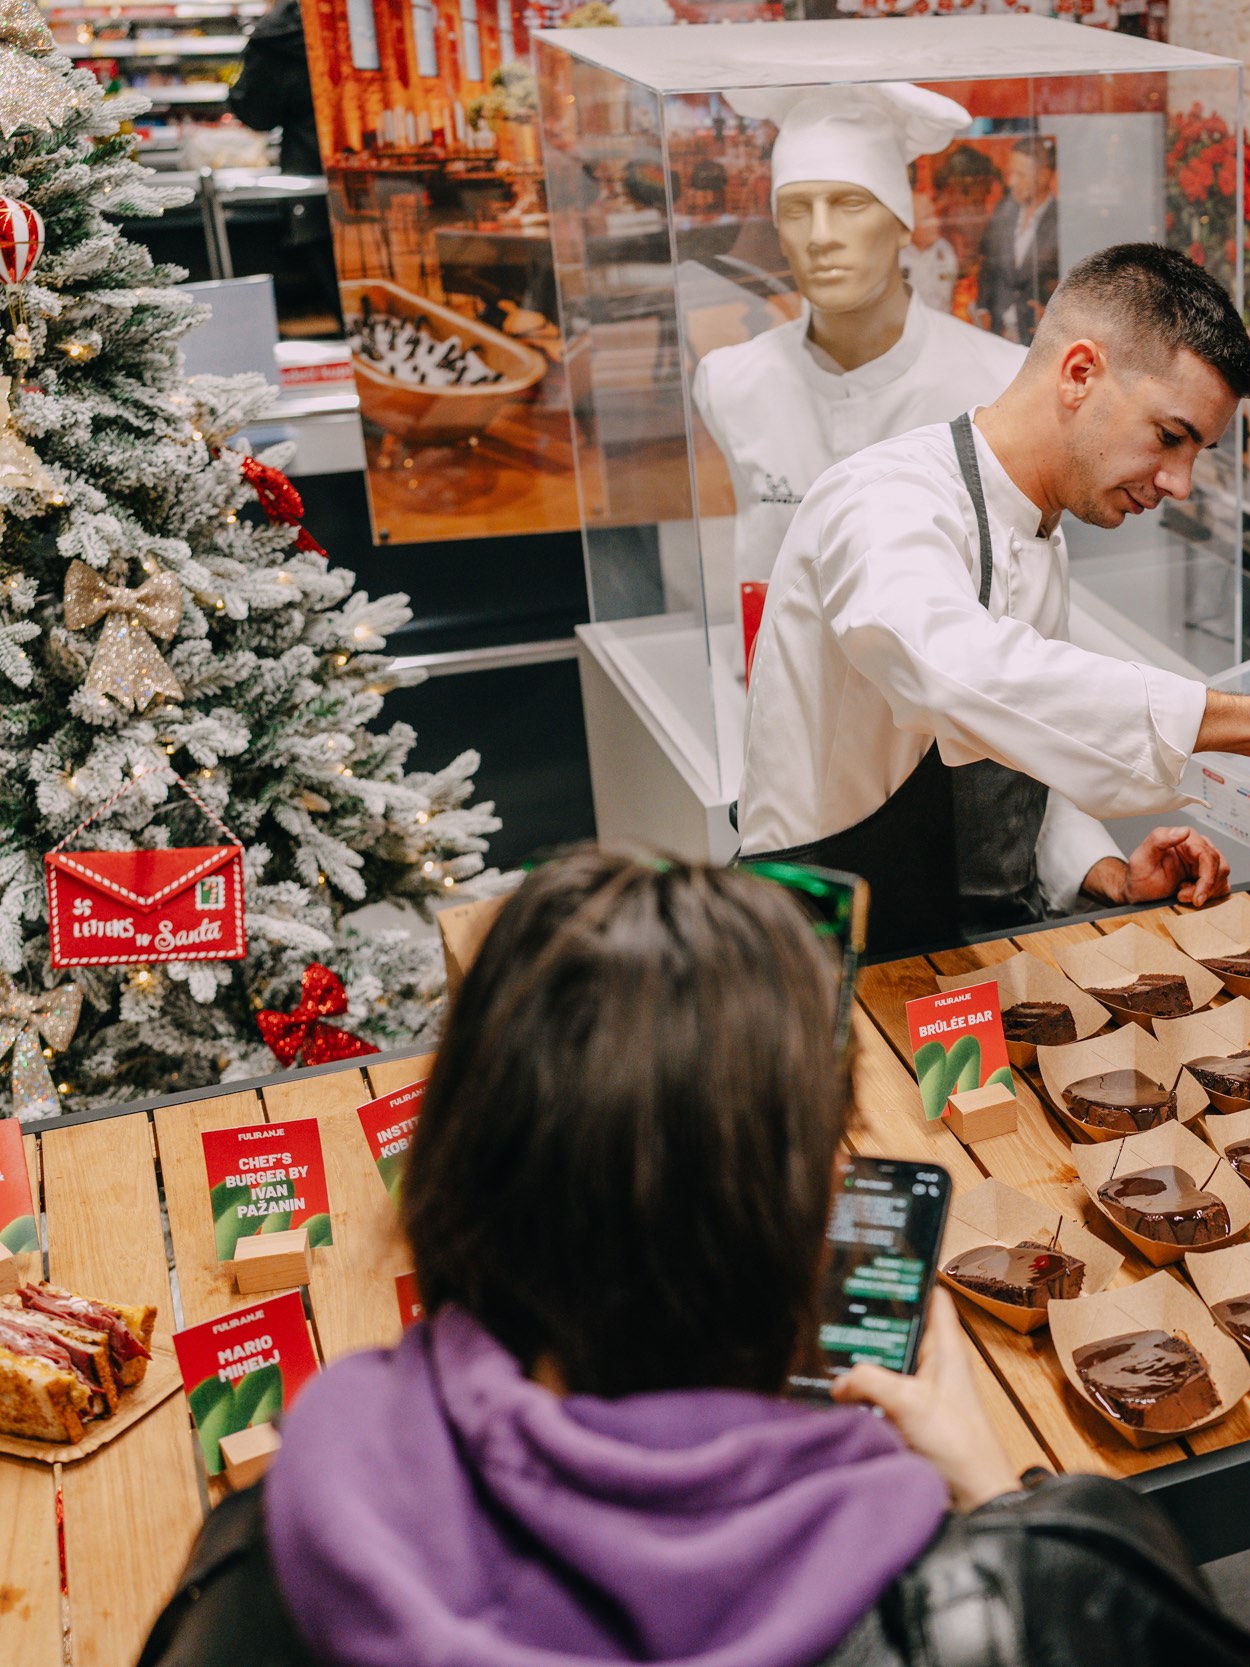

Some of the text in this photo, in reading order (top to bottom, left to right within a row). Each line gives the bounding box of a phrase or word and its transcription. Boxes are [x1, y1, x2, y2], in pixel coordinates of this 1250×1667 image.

[72, 917, 135, 939] LETTERS
[154, 917, 223, 952] Santa
[934, 993, 972, 1008] FULIRANJE
[918, 1010, 993, 1038] BRÛLÉE BAR
[237, 1128, 285, 1142] FULIRANJE
[238, 1152, 292, 1171] CHEF'S
[225, 1165, 309, 1189] BURGER BY
[250, 1183, 289, 1201] IVAN
[237, 1197, 306, 1219] PAŽANIN
[212, 1309, 265, 1335] FULIRANJE
[217, 1335, 274, 1366] MARIO
[218, 1349, 281, 1384] MIHELJ
